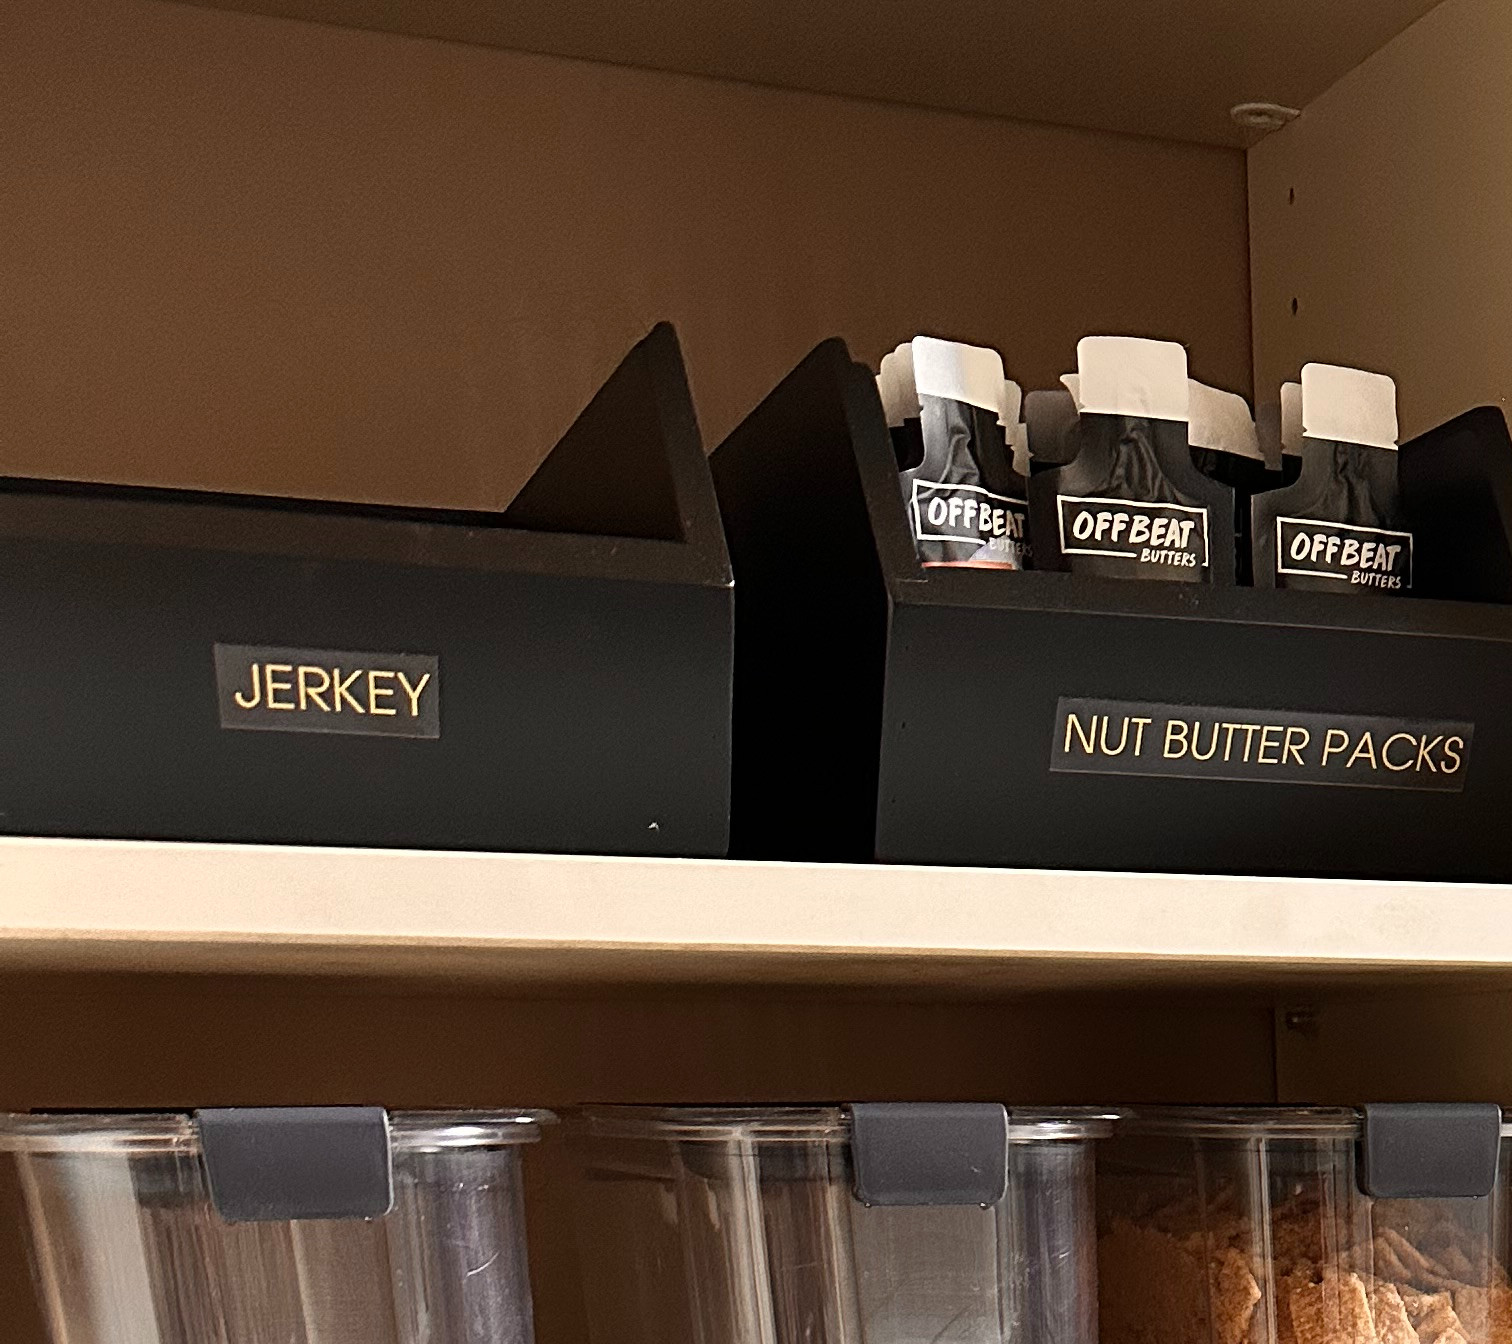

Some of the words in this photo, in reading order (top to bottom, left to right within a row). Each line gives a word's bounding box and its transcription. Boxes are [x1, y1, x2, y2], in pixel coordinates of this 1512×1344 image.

[927, 496, 1025, 538] OFFBEAT
[1072, 510, 1195, 549] OFFBEAT
[1140, 547, 1197, 567] BUTTERS
[1290, 532, 1401, 572] OFFBEAT
[1350, 570, 1402, 589] BUTTERS
[234, 662, 431, 717] JERKEY
[1063, 713, 1152, 757] NUT
[1162, 719, 1310, 766] BUTTER
[1320, 729, 1464, 774] PACKS
